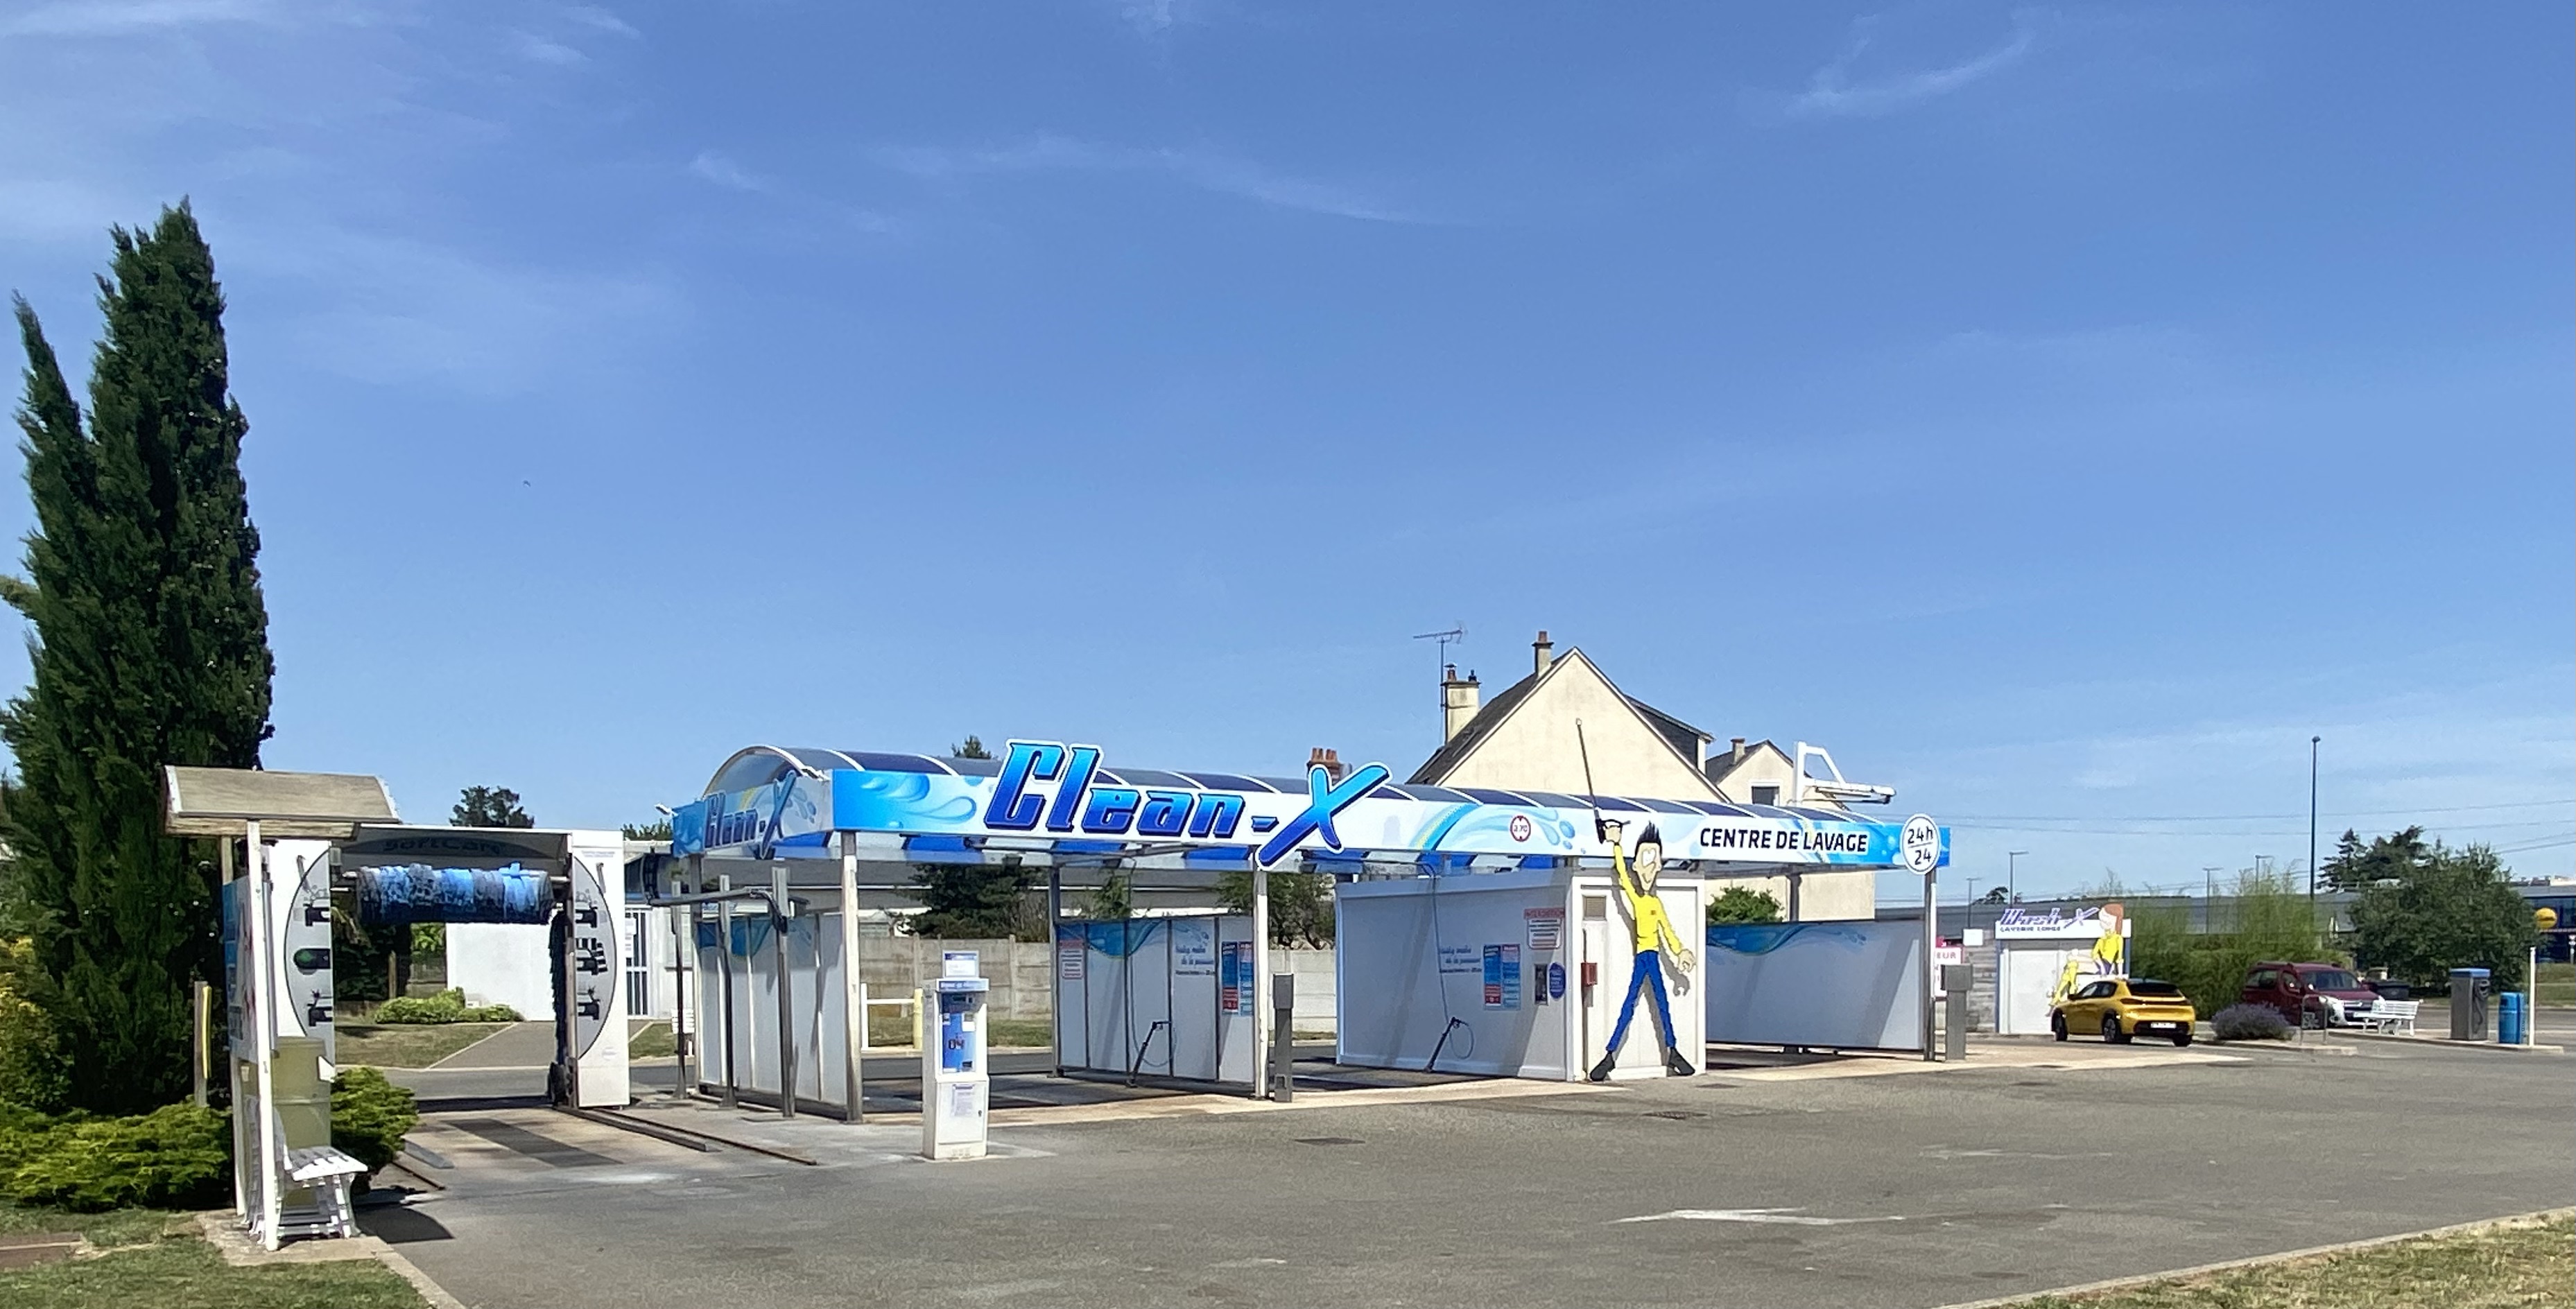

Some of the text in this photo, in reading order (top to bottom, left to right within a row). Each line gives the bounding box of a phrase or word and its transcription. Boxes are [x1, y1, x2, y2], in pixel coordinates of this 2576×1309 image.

[705, 771, 795, 857] Clean-X
[985, 740, 1390, 868] Clean-X
[1700, 828, 1868, 852] CENTRE DE LAVAGE
[1908, 826, 1934, 844] 24h
[1914, 850, 1932, 865] 24
